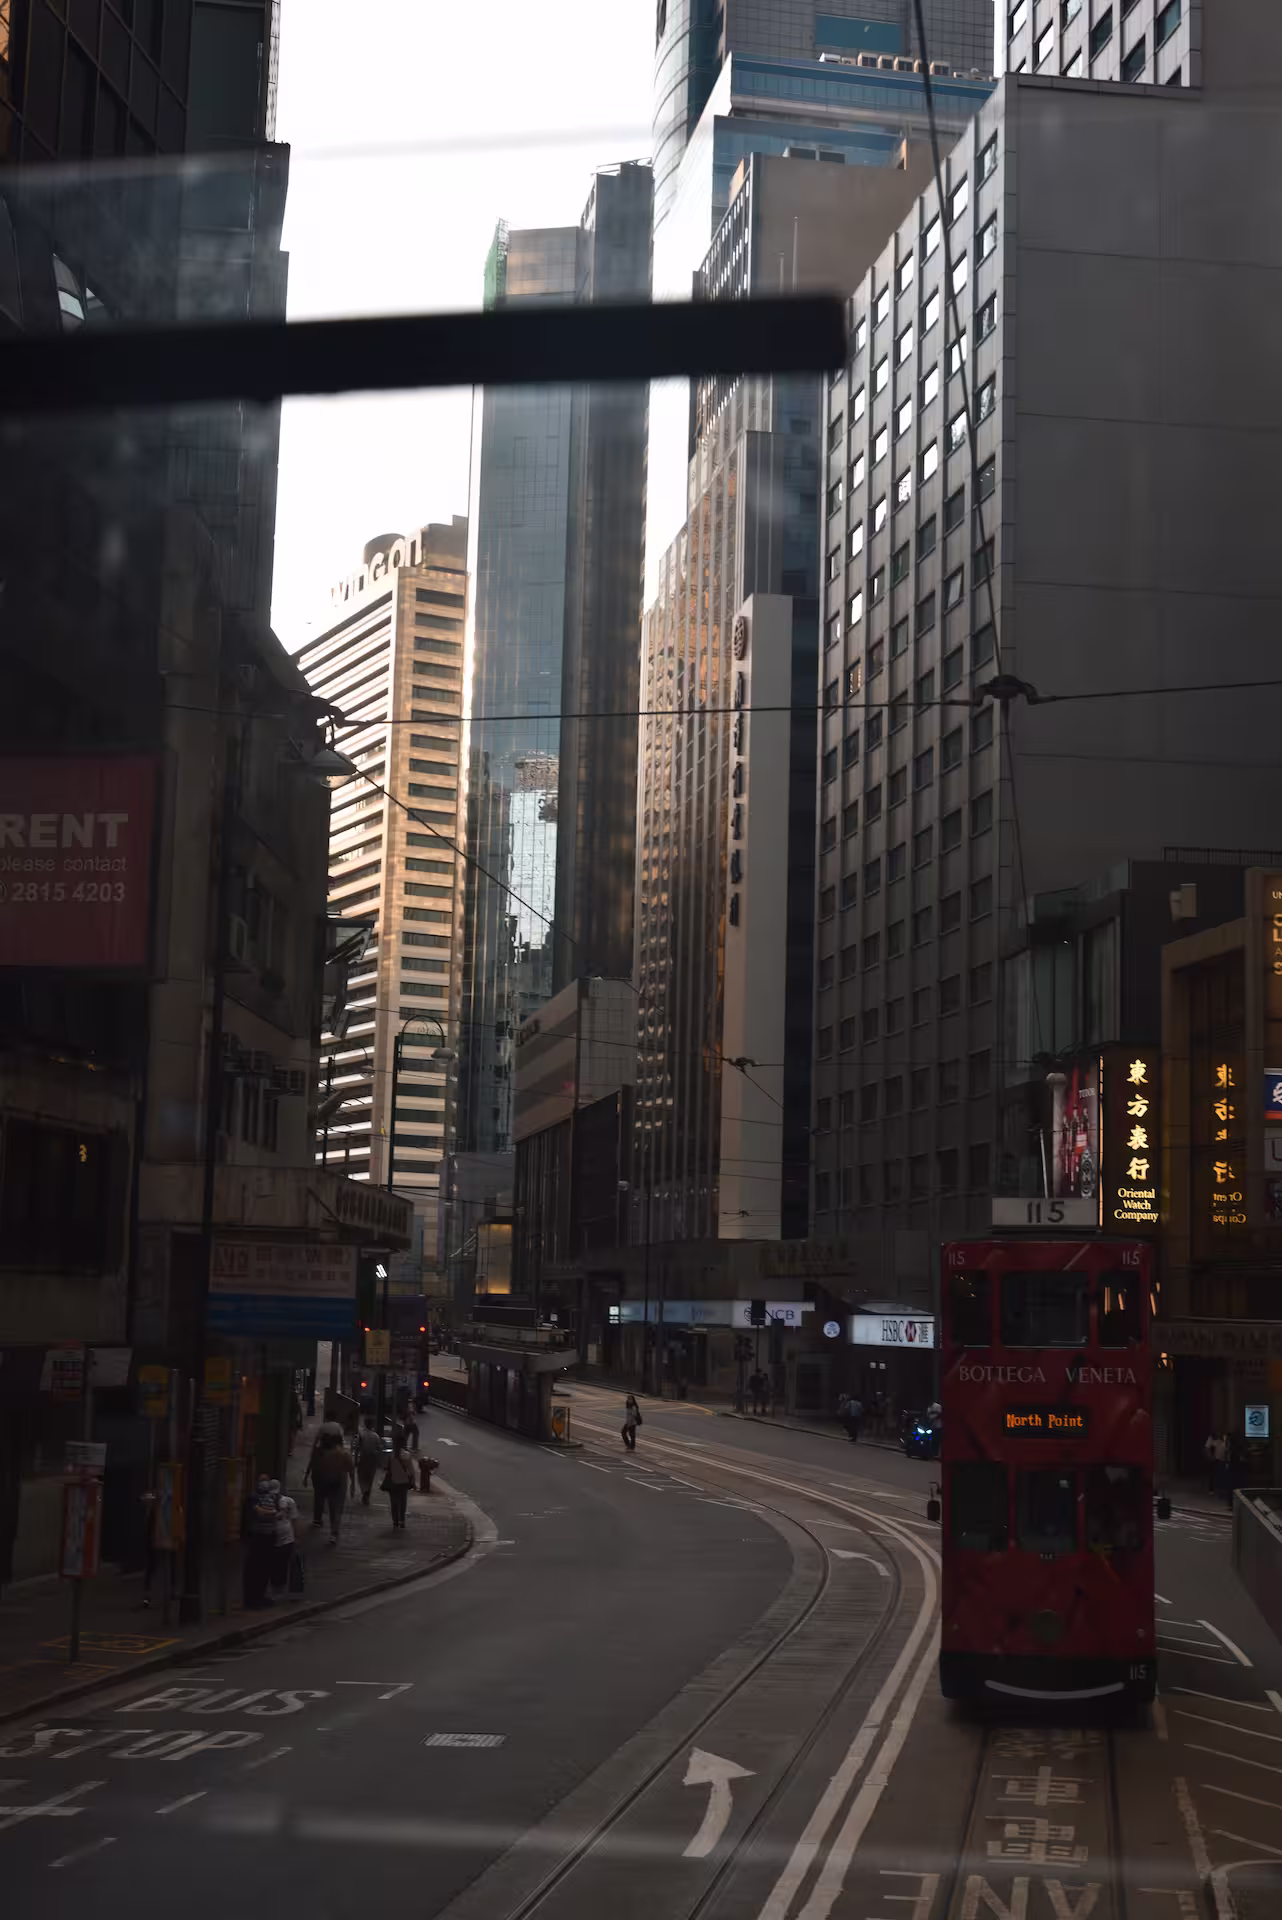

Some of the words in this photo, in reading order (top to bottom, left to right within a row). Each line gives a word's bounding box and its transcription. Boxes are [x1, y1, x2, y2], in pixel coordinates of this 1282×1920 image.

[0, 813, 129, 848] RENT
[64, 856, 128, 872] contact
[11, 881, 66, 902] 2815
[72, 882, 126, 902] 4203
[1126, 1059, 1150, 1180] 東方表行
[1117, 1187, 1156, 1199] Oriental
[1027, 1201, 1065, 1223] 115
[1123, 1199, 1152, 1211] Watch
[1114, 1209, 1159, 1223] Company
[949, 1250, 965, 1265] 115
[1122, 1250, 1140, 1265] 115
[882, 1319, 905, 1342] HSBC
[959, 1366, 1047, 1383] BOTTEGA
[1065, 1367, 1137, 1384] VENETA
[1006, 1413, 1042, 1428] North
[1048, 1414, 1083, 1428] Point
[1130, 1664, 1147, 1680] 115
[113, 1687, 331, 1715] BUS
[0, 1727, 265, 1760] STOP
